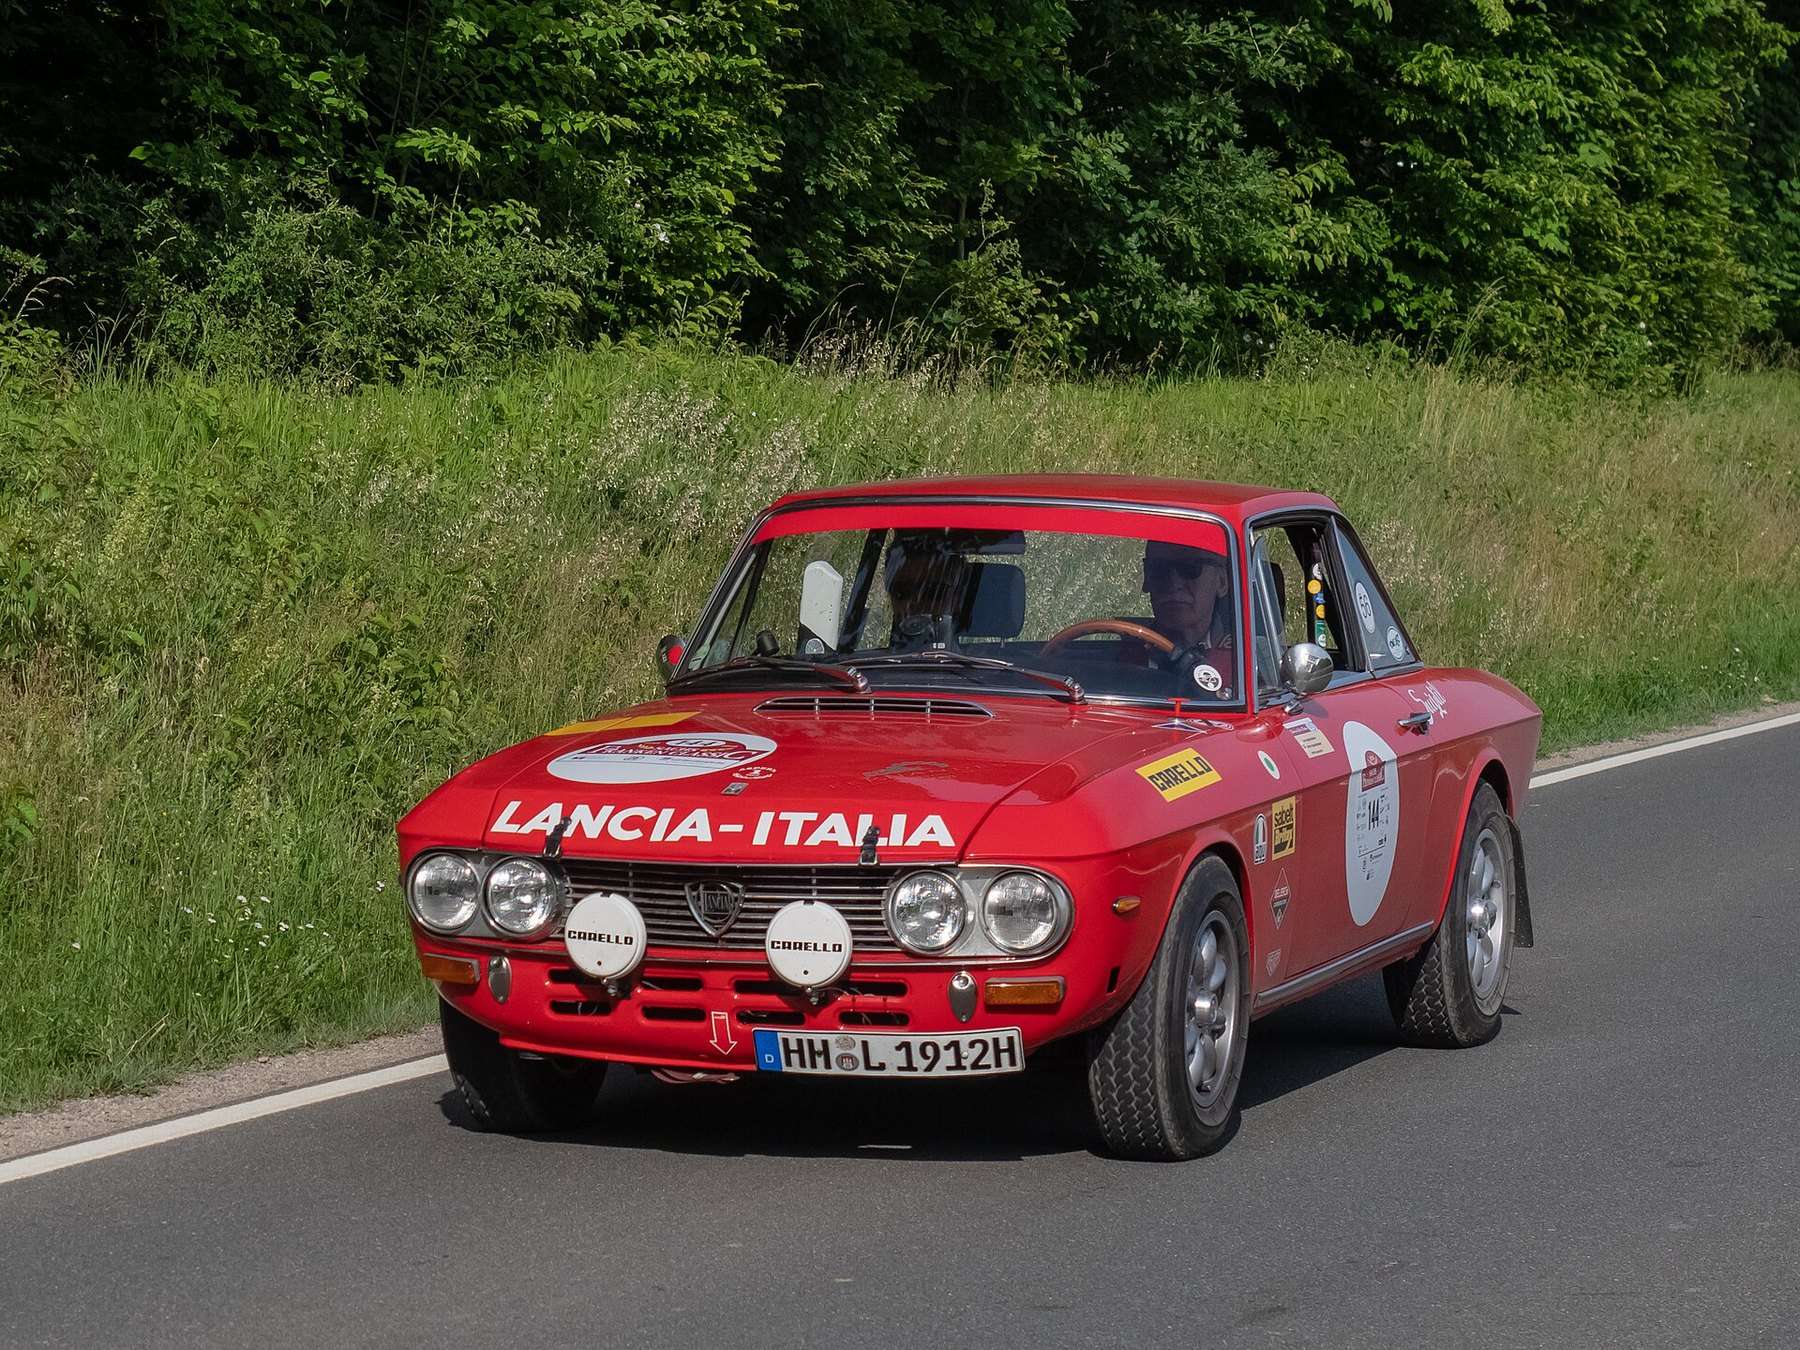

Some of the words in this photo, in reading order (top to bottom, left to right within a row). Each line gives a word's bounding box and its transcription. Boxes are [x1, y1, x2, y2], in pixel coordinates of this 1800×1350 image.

[1148, 756, 1213, 792] CARELLO
[567, 930, 633, 946] CARELLO
[770, 940, 842, 953] CARELLO
[764, 1053, 775, 1064] D
[781, 1037, 832, 1070] HH
[861, 1040, 886, 1071] L
[894, 1035, 1017, 1072] 1912H
